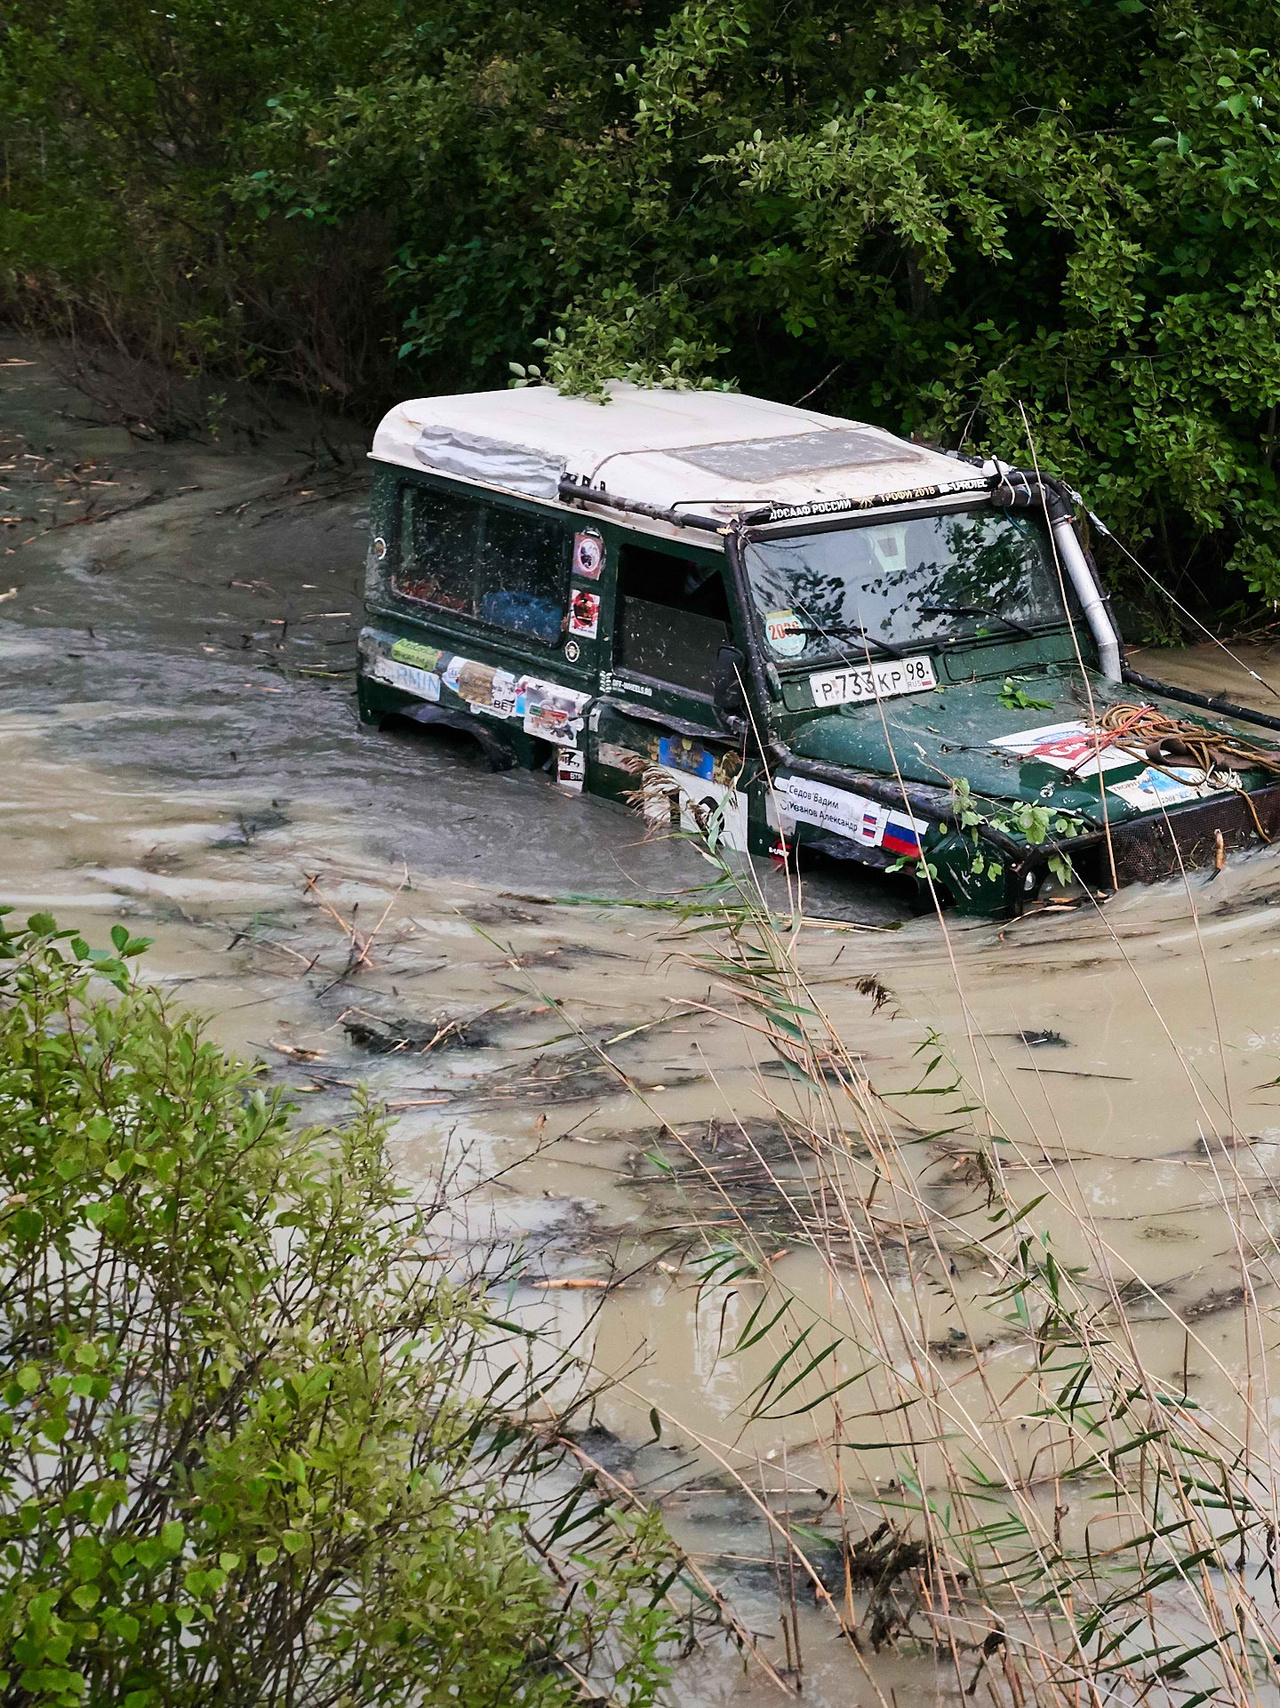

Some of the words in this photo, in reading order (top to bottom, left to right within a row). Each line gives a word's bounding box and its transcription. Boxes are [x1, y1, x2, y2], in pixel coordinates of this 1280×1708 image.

[879, 489, 913, 503] ТРОФИ
[914, 486, 936, 498] 2018
[769, 503, 811, 521] ДОСААФ
[812, 499, 852, 515] РОССИИ
[788, 784, 812, 801] Седов
[813, 792, 839, 809] Вадим
[819, 811, 858, 832] Александр
